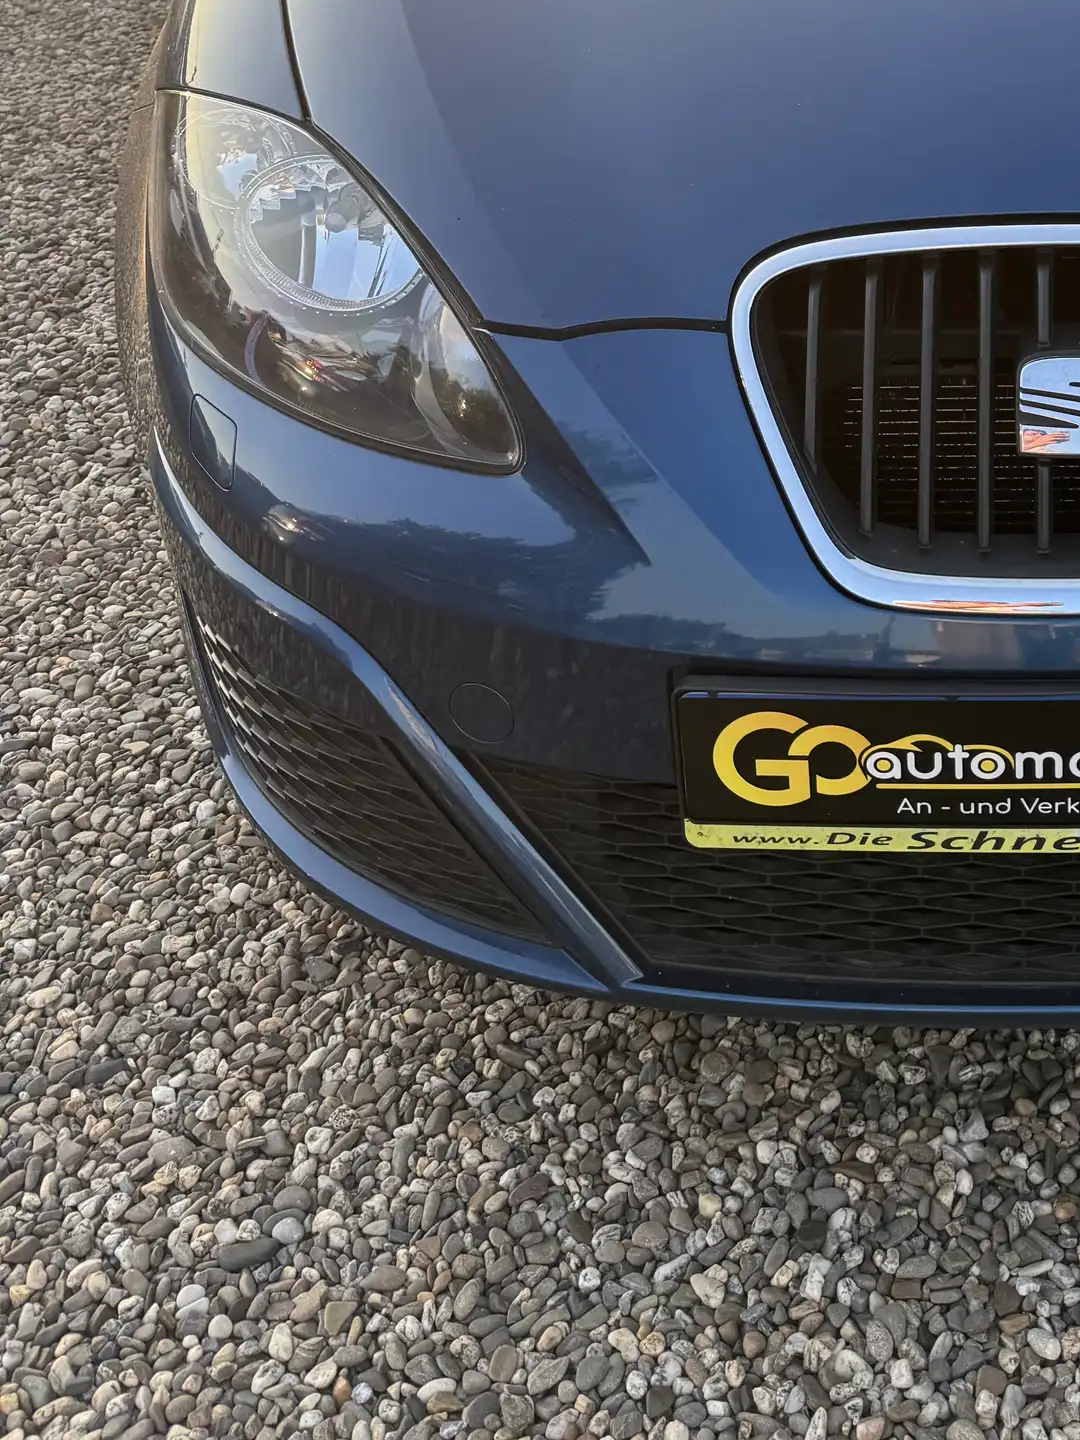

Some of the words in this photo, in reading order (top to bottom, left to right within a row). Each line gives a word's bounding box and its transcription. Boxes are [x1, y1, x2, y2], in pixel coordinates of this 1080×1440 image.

[712, 711, 871, 806] GO
[896, 797, 932, 814] An
[960, 797, 1012, 814] und
